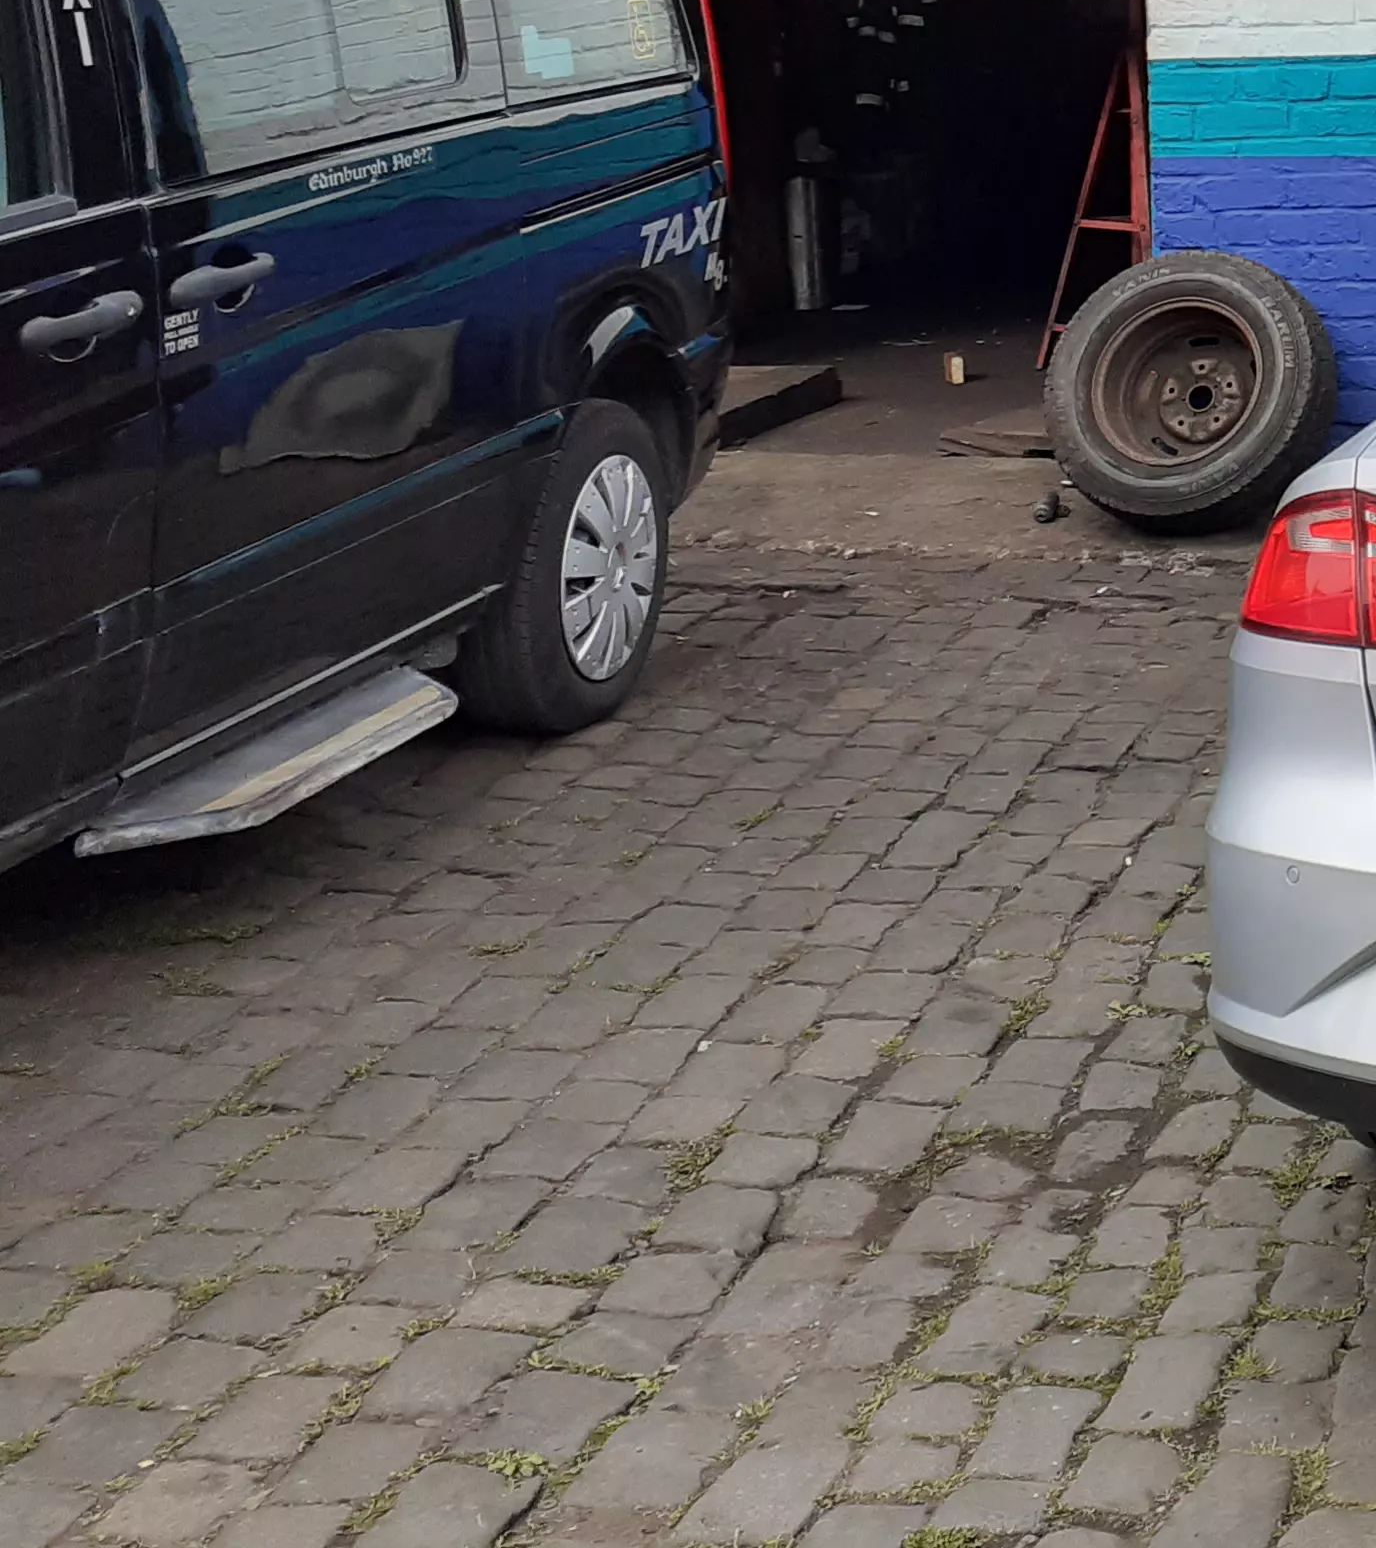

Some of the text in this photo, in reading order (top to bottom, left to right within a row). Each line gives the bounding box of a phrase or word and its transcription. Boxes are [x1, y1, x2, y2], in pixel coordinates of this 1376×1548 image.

[308, 158, 389, 191] Edinburgh
[640, 197, 727, 269] TAXI
[164, 308, 200, 330] GENTLY
[164, 334, 200, 356] TO OPEN
